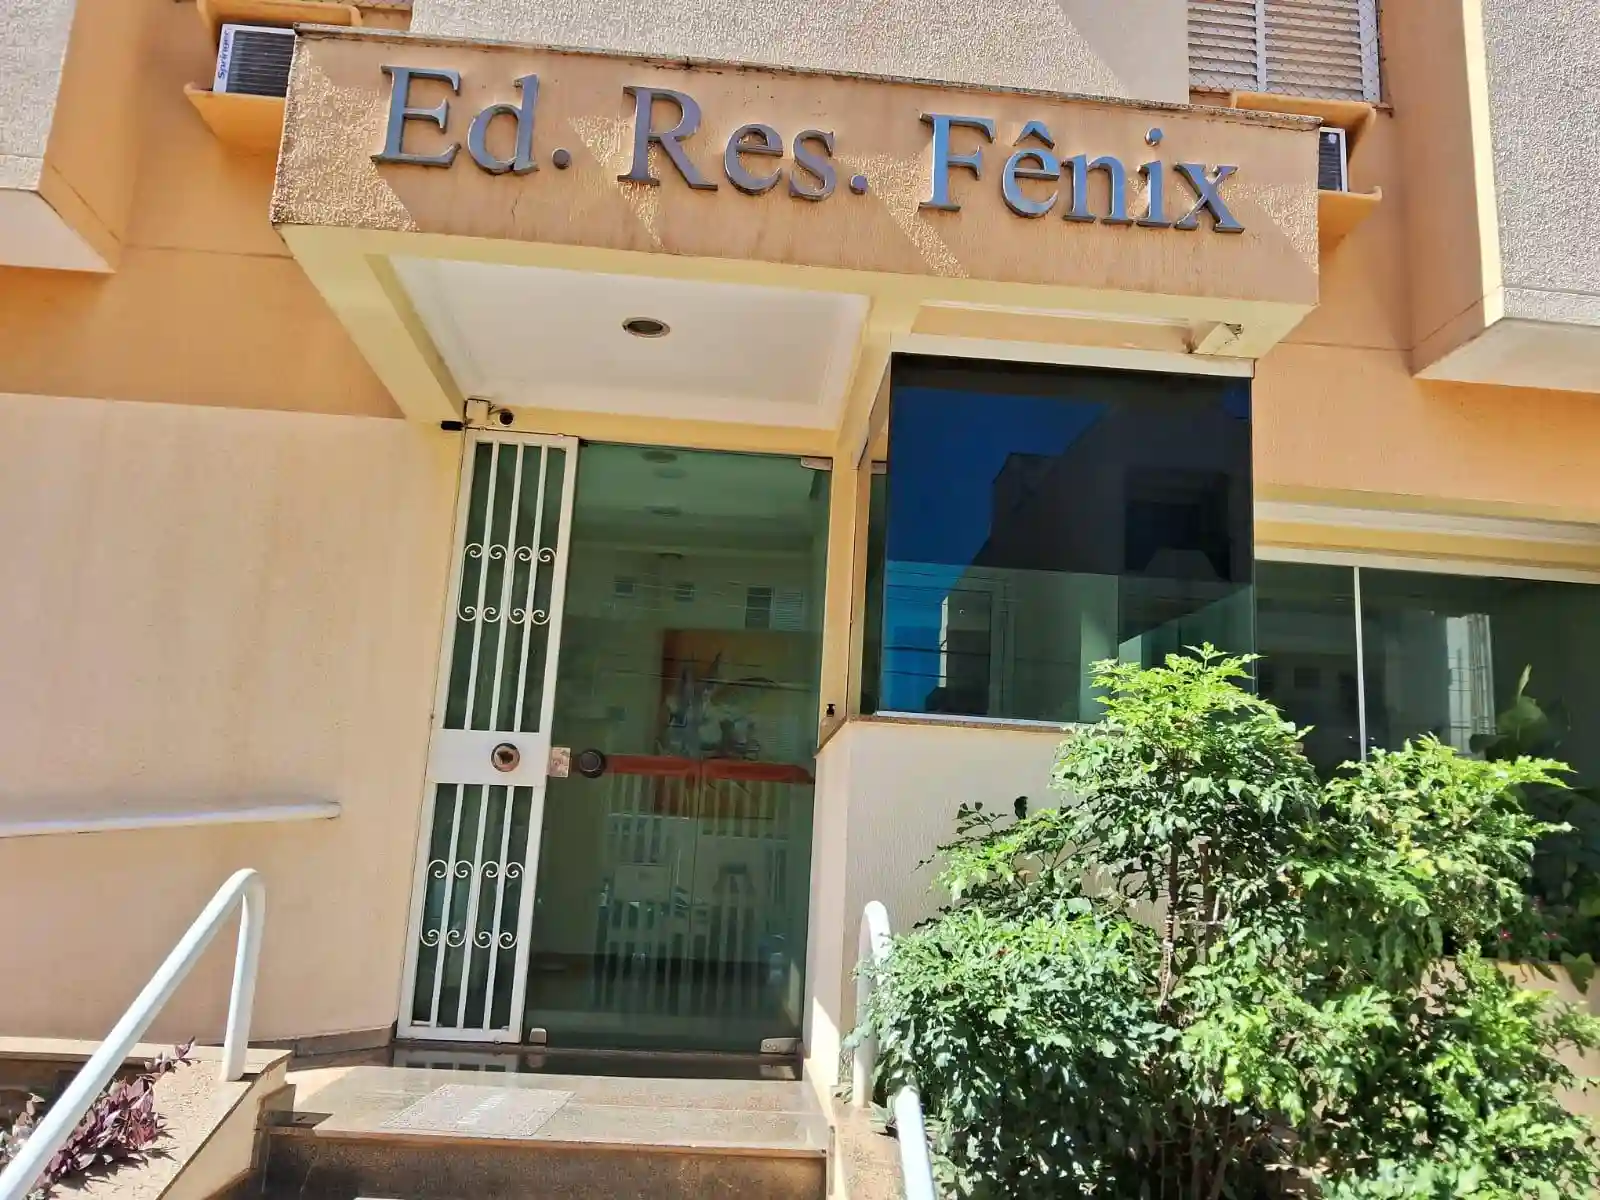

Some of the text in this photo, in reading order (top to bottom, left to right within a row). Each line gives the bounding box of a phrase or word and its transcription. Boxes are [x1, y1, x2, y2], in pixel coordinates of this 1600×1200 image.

[218, 28, 230, 80] Springer
[369, 65, 1245, 234] Ed. Res. Fênix
